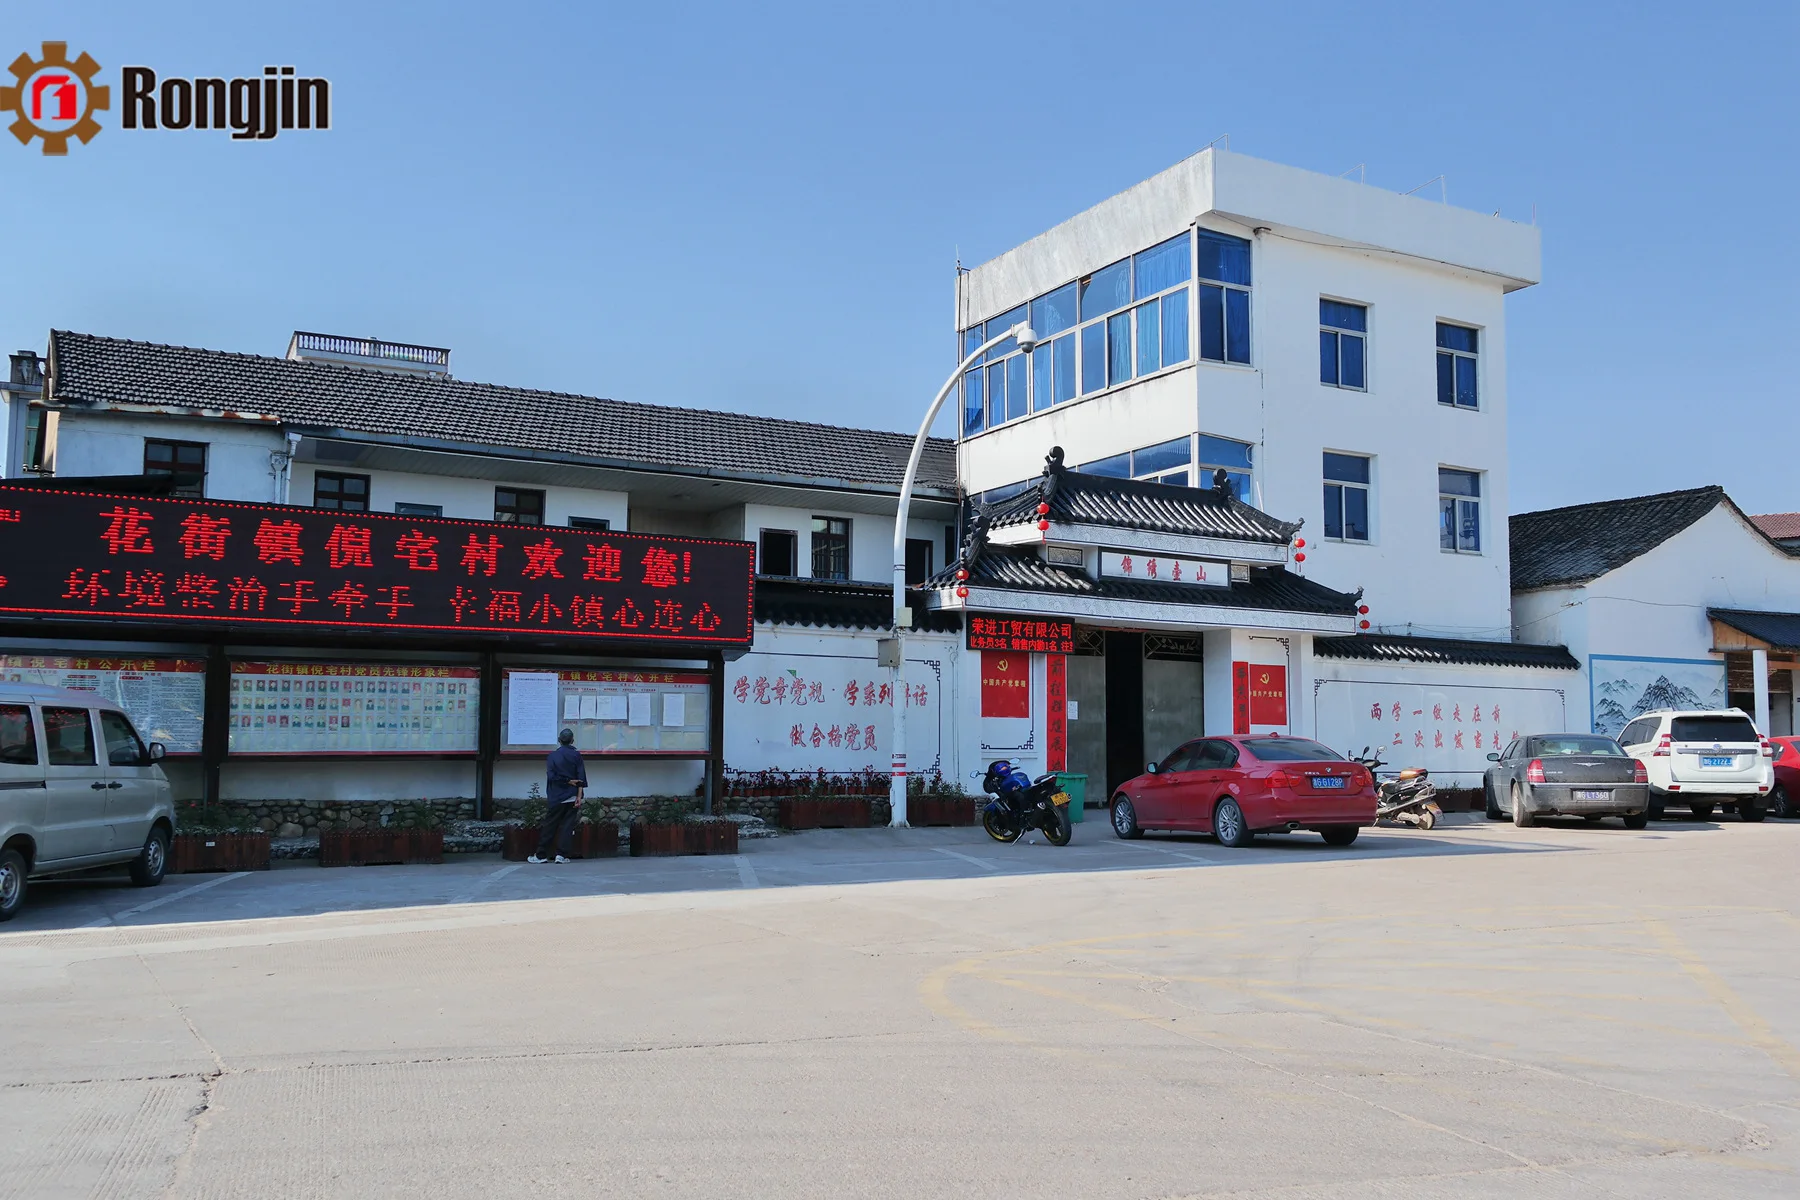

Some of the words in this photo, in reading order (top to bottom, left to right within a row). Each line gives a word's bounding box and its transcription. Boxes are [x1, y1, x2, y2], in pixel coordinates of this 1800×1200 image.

[100, 506, 692, 588] 花街镇倪宅村欢迎您!
[972, 618, 1072, 639] 荣进工贸有限公司
[1371, 701, 1500, 723] 两学一做走在前
[790, 723, 878, 751] 做合格党员
